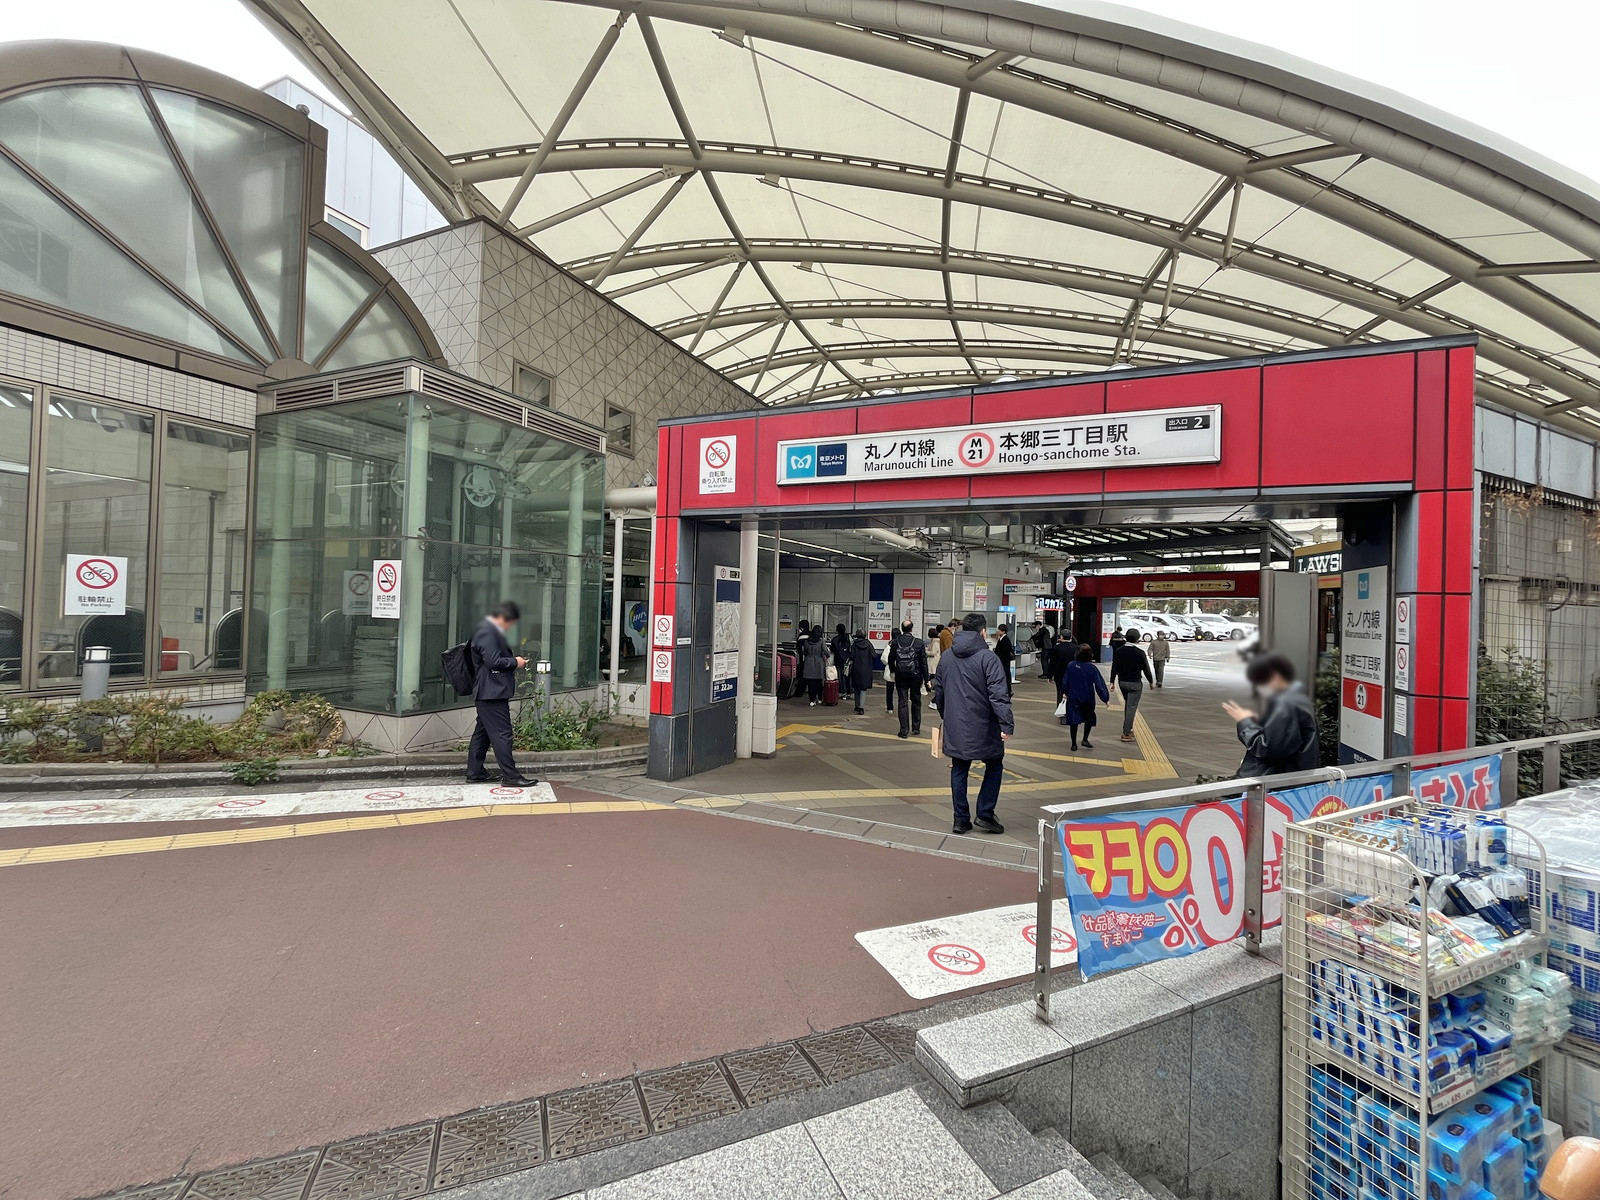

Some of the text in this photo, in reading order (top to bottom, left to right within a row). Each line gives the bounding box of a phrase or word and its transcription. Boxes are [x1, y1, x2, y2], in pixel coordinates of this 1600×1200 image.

[1193, 416, 1204, 429] 2
[970, 438, 982, 448] M
[999, 423, 1129, 451] 本郷三丁目駅
[864, 438, 936, 460] 丸ノ内線
[967, 448, 984, 460] 21
[998, 444, 1141, 466] Hongo-sanchome Sta.
[864, 456, 954, 472] Marunouchi Line
[1298, 553, 1342, 574] LAWS
[78, 595, 115, 603] 駐輪禁止
[1346, 609, 1381, 629] 丸ノ内線
[1345, 629, 1382, 641] Marunouchi Line
[1344, 653, 1381, 672] 本郷三丁目駅
[1357, 694, 1364, 705] 21
[1494, 975, 1507, 986] 20
[1502, 995, 1515, 1006] 20
